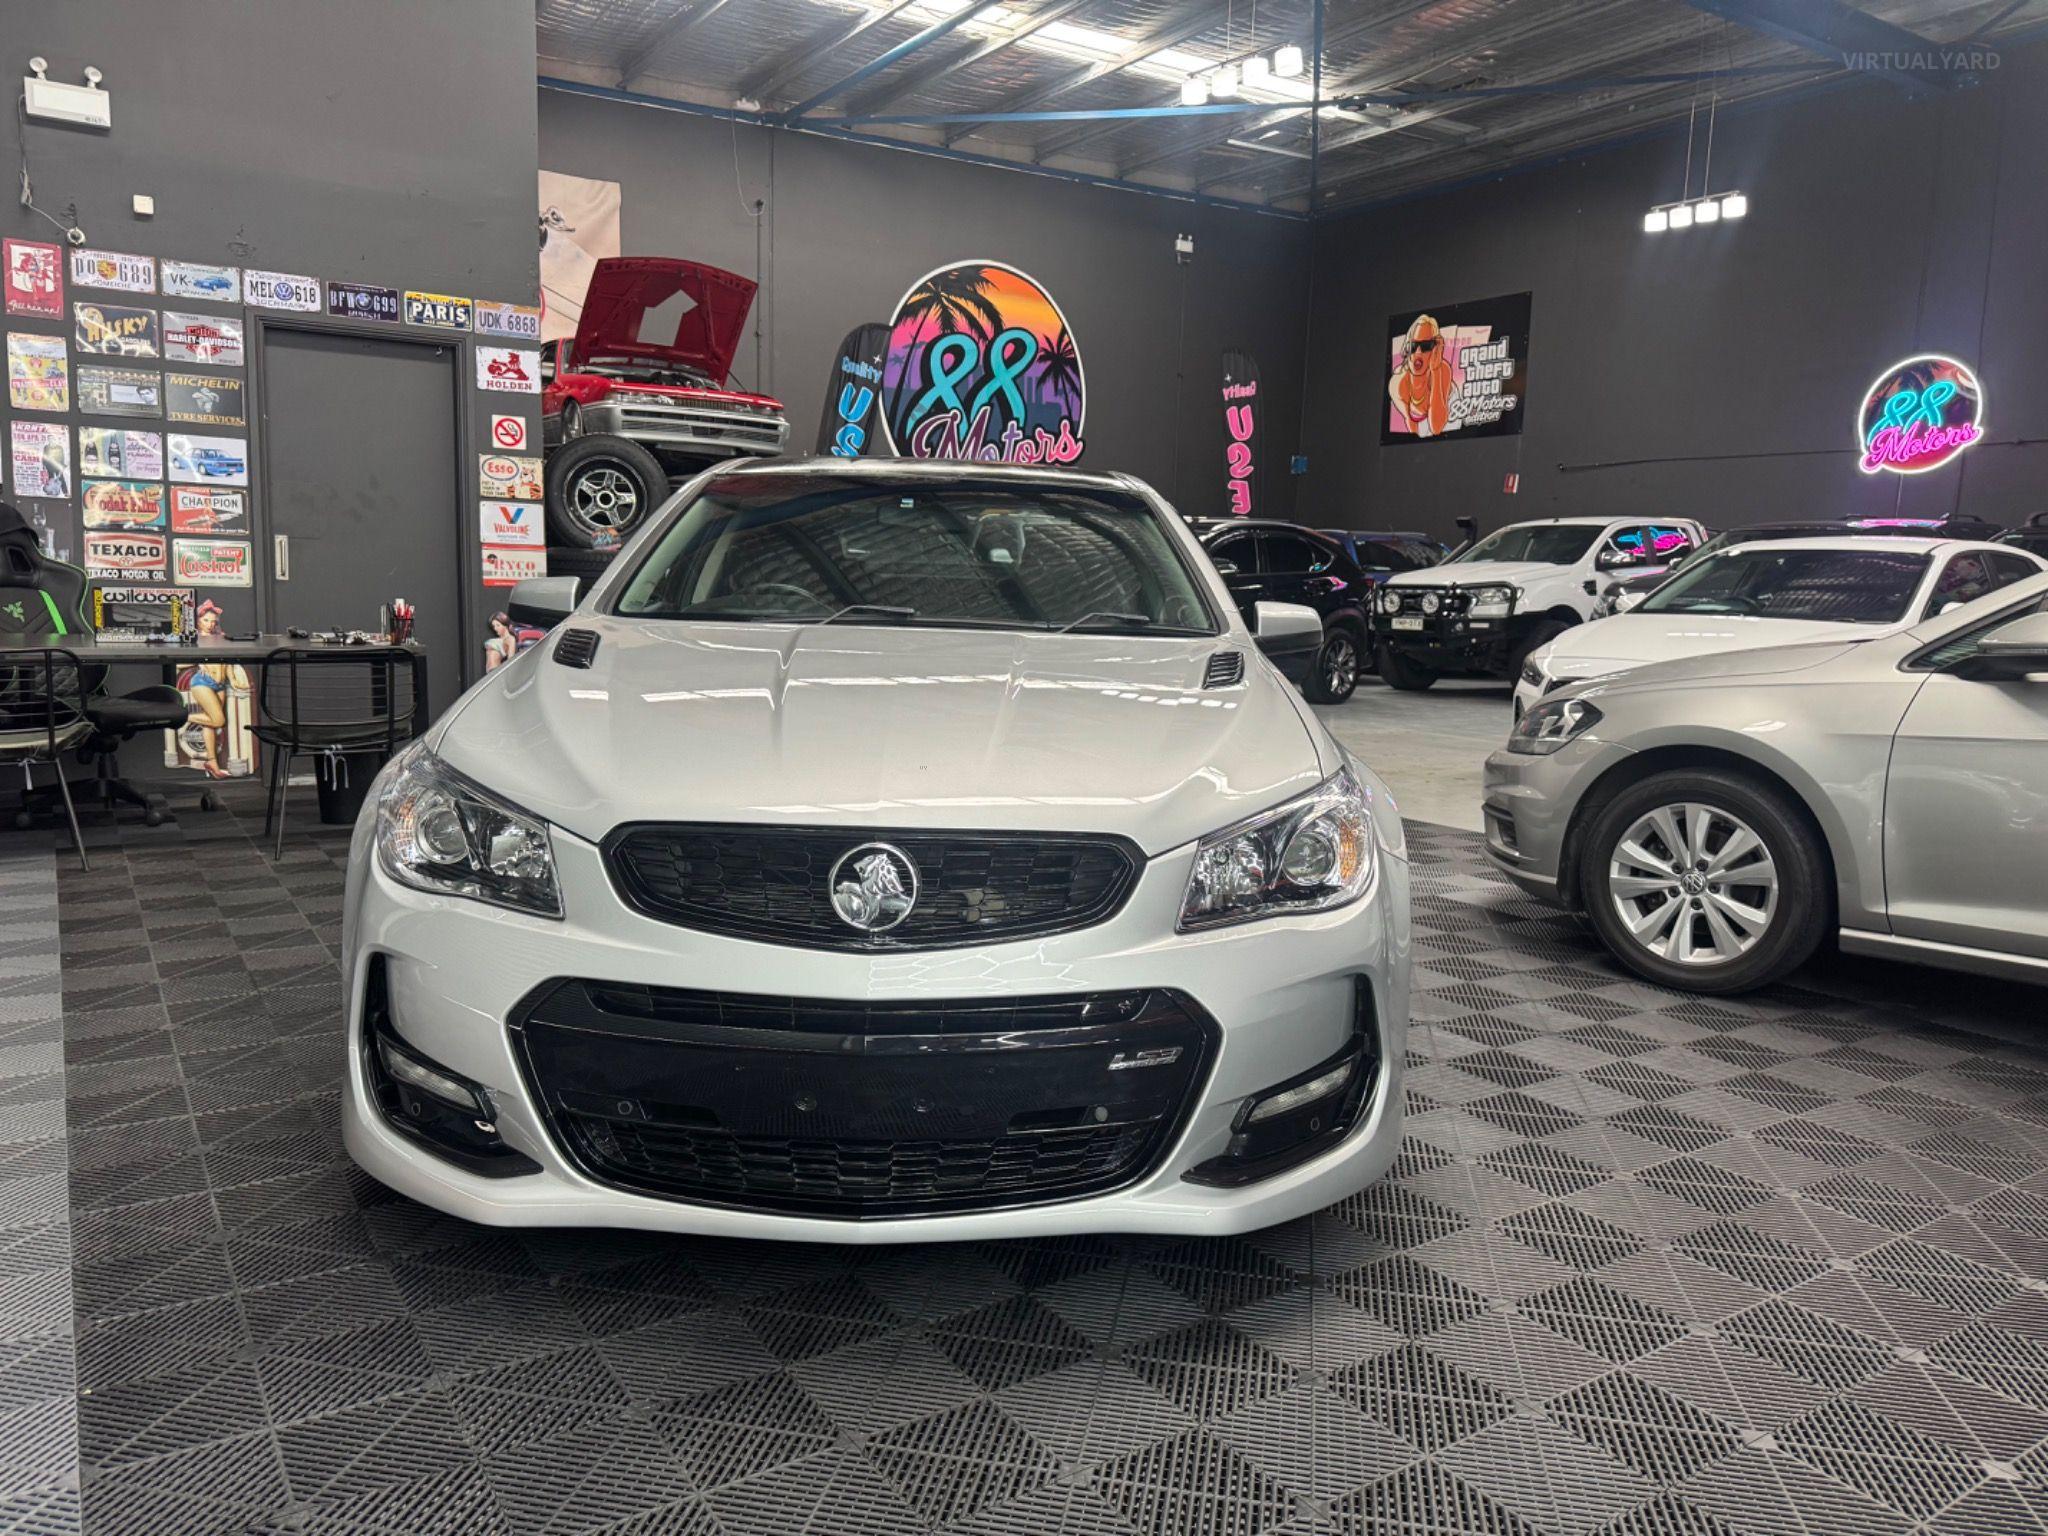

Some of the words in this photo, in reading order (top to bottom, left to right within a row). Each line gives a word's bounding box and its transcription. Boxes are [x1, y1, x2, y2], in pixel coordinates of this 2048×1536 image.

[119, 262, 152, 285] 689
[249, 280, 275, 298] MEL
[295, 285, 317, 303] 618
[412, 302, 466, 323] PARIS
[479, 311, 503, 329] UDK
[507, 314, 536, 333] 6868
[167, 332, 241, 349] HARLEY-DAVIDSON
[1460, 339, 1507, 367] grand
[842, 356, 882, 384] Quality
[1466, 360, 1513, 381] theft
[169, 375, 241, 390] MICHELIN
[486, 380, 533, 390] HOLDEN
[905, 328, 1038, 440] 88
[1463, 379, 1500, 397] auto
[170, 412, 196, 422] TYRE
[197, 413, 245, 425] SERVICES
[1868, 381, 1957, 445] 88
[912, 406, 1083, 463] Motors
[1860, 420, 1980, 472] Motors
[494, 523, 530, 536] VALVOLINE
[90, 543, 160, 558] TEXACO
[88, 569, 119, 579] TEXACO
[121, 570, 150, 580] MOTOR
[152, 571, 166, 581] OIL
[181, 552, 242, 579] Castrol
[494, 559, 536, 571] RYCO
[104, 590, 193, 603] wilwood
